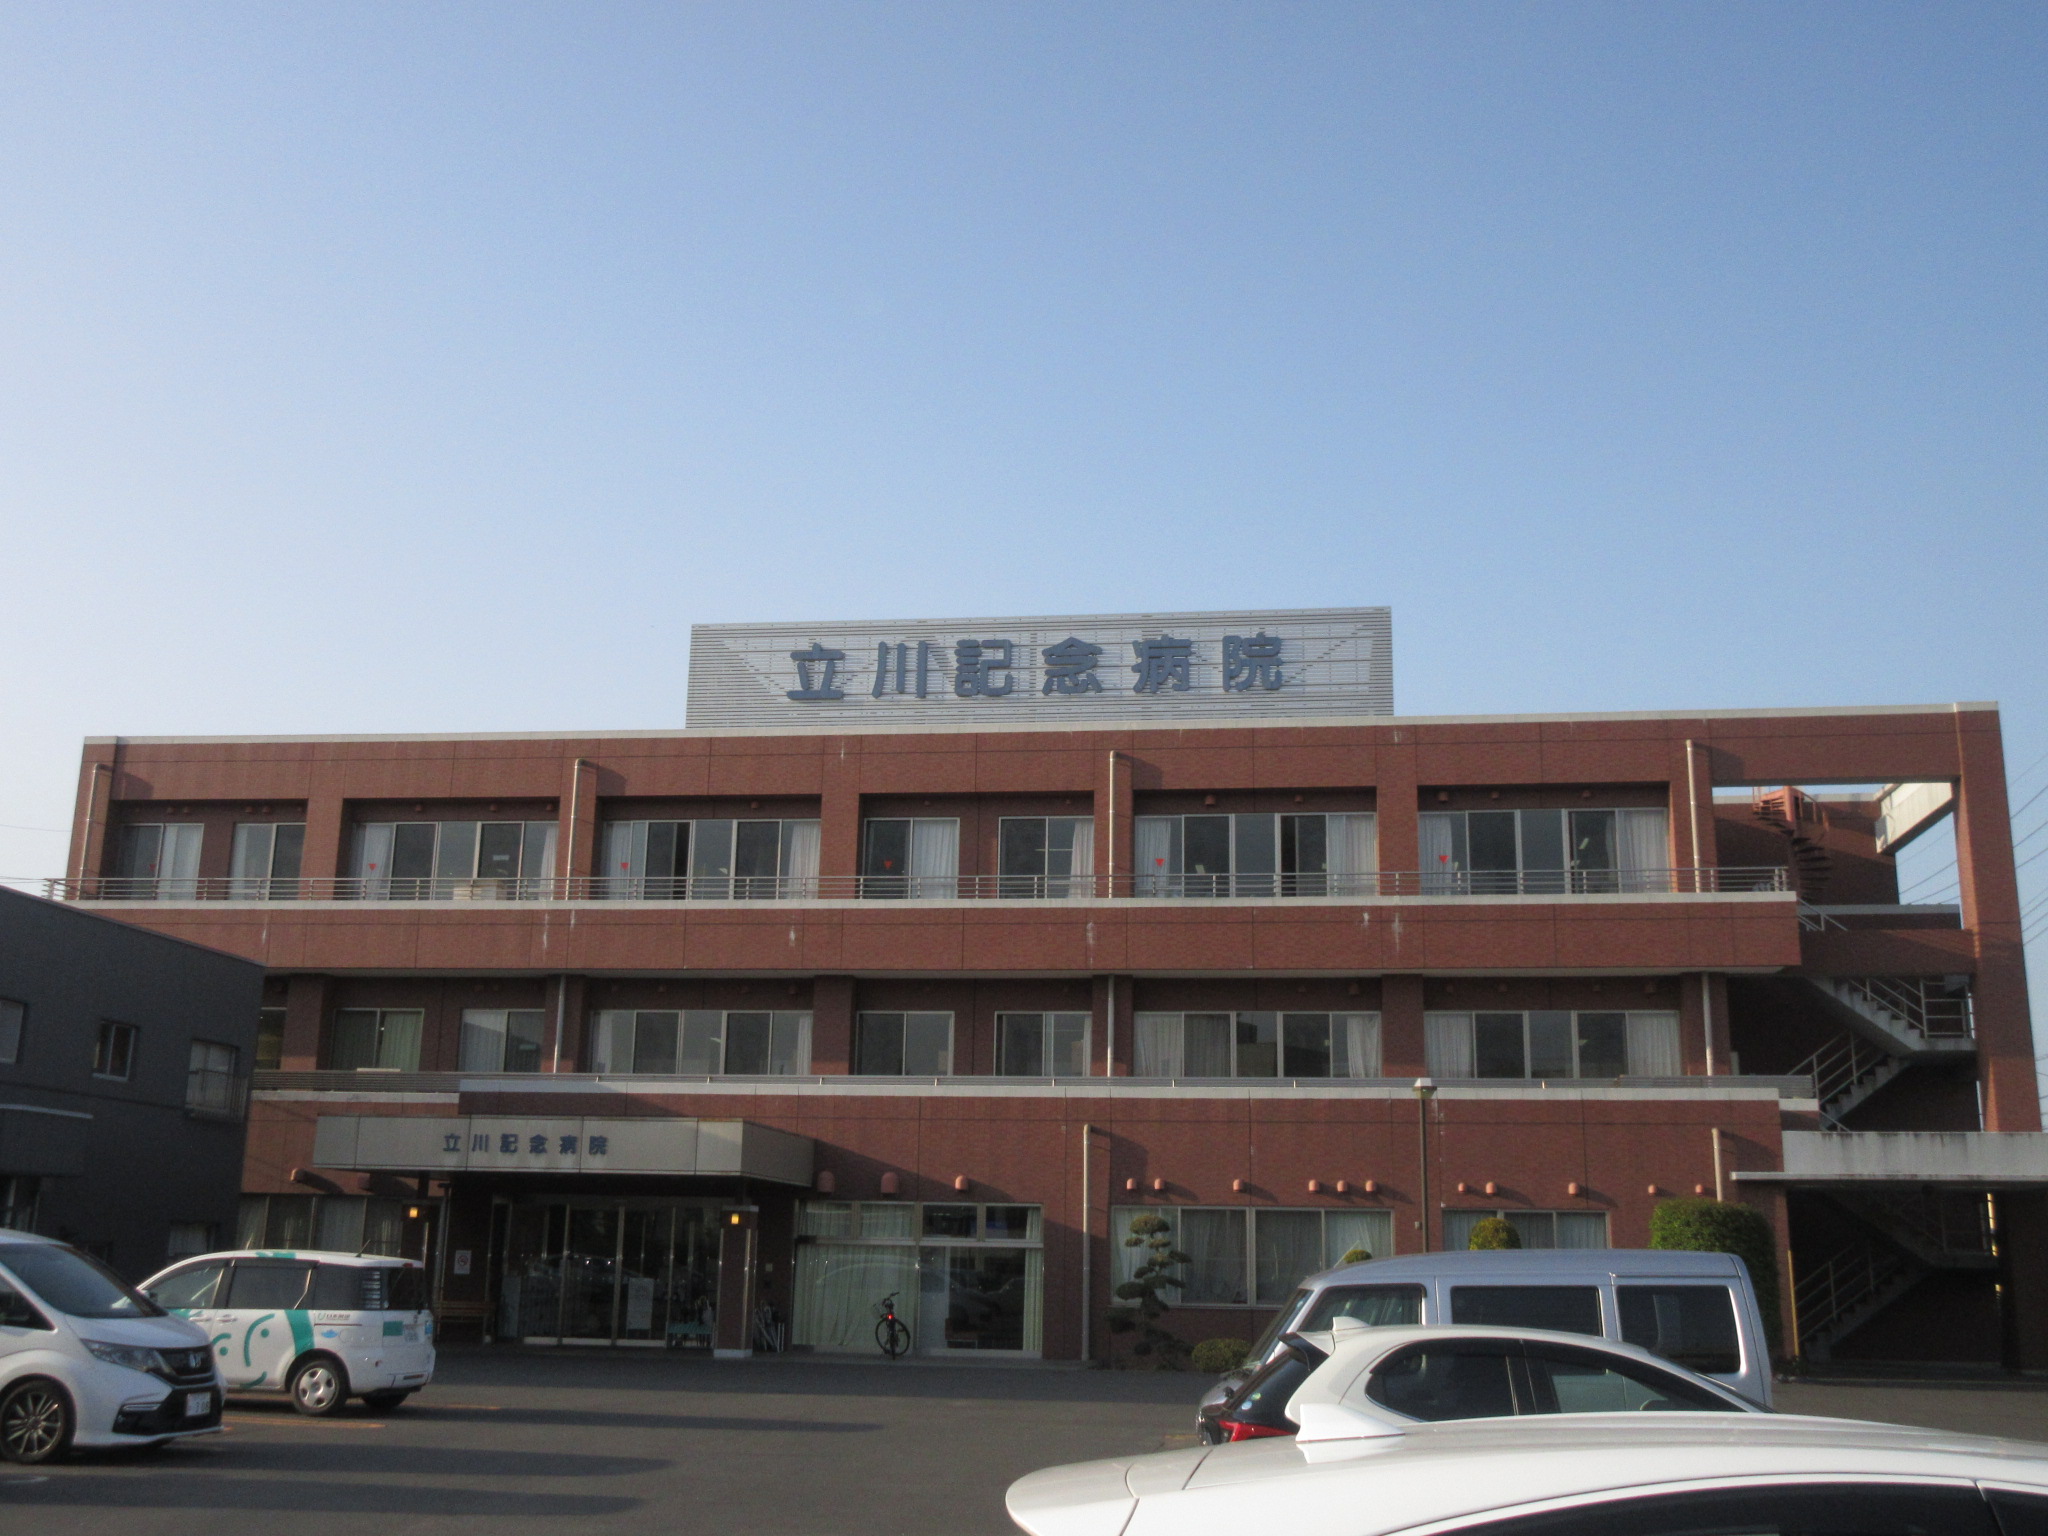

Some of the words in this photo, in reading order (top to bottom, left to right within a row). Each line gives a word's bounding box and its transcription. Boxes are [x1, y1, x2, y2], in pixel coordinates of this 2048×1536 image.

[787, 632, 1284, 700] 立川記念病院
[443, 1133, 608, 1155] 立川記念病院
